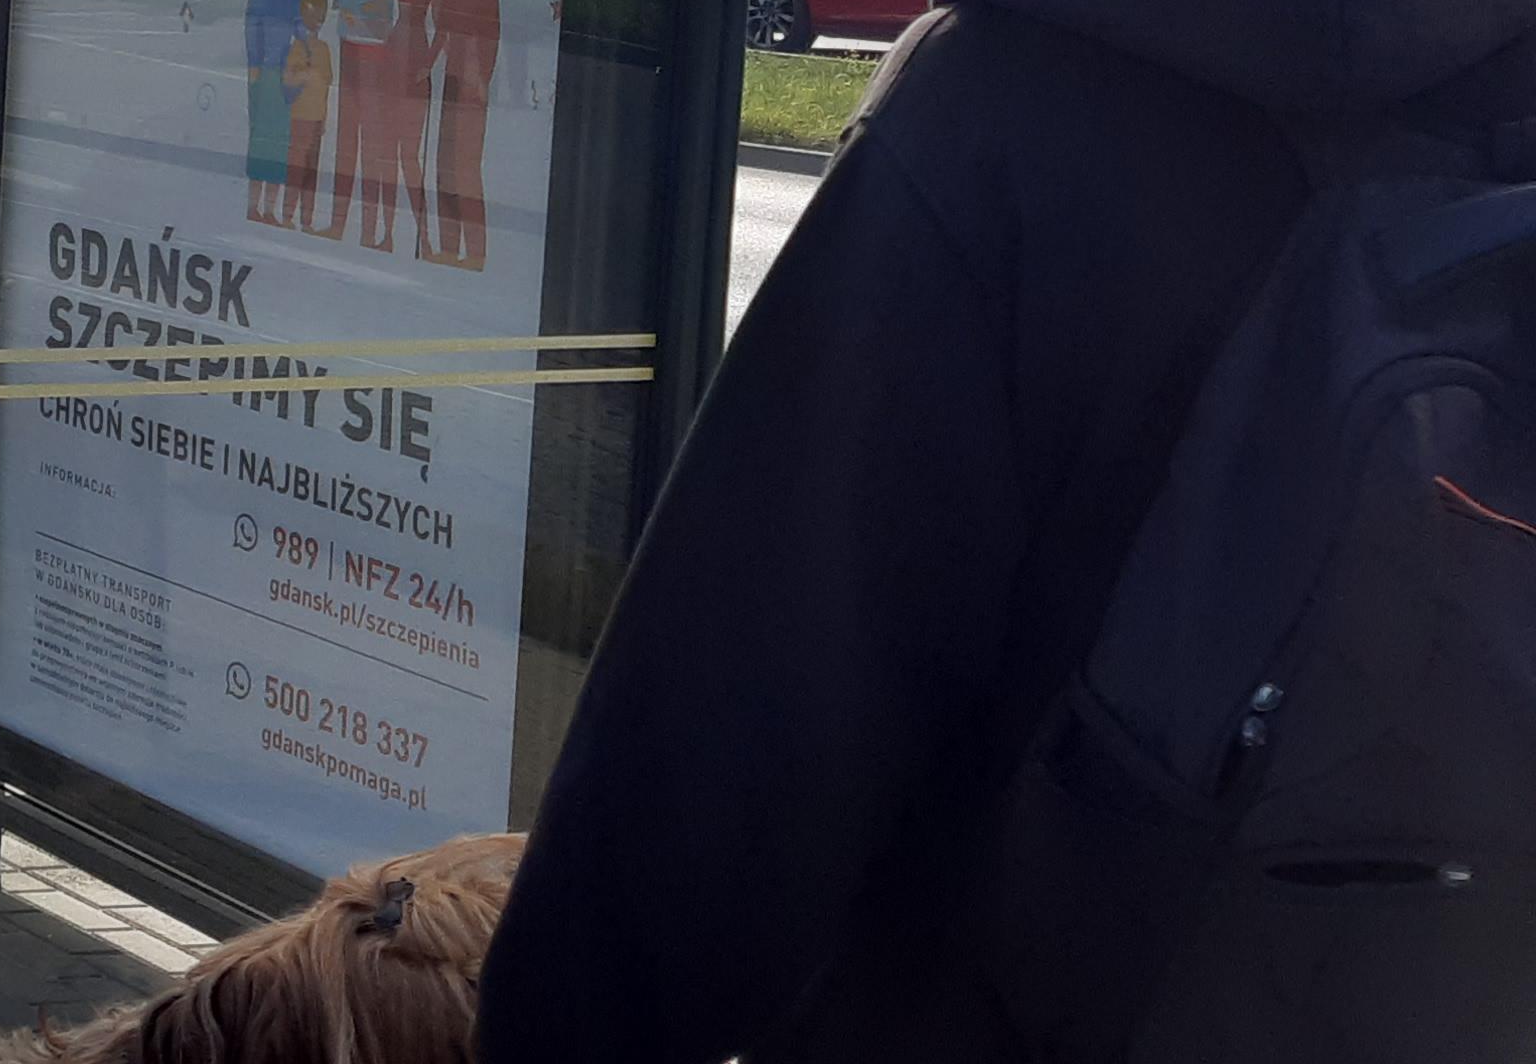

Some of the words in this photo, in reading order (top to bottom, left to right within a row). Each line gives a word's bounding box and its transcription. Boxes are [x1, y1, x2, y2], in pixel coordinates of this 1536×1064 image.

[48, 221, 253, 329] GDAŃSK
[39, 395, 123, 440] CHROŃ
[130, 415, 215, 471] SIEBIE
[237, 449, 454, 550] NAJBLIŻSZYCH
[39, 461, 117, 498] INFORMACJA:
[340, 387, 434, 484] SIĘ
[35, 548, 99, 586] BEZPŁATNY
[102, 574, 173, 612] TRANSPORT
[35, 568, 45, 582] W
[104, 595, 127, 618] DLA
[269, 575, 482, 671] gdansk.pl/szczepienia
[272, 525, 320, 572] 989
[344, 548, 401, 602] NFZ
[408, 571, 476, 628] 24/h
[260, 724, 428, 812] gdanskpomaga.pl
[263, 674, 311, 723] 500
[318, 695, 369, 747] 218
[375, 716, 429, 769] 337
